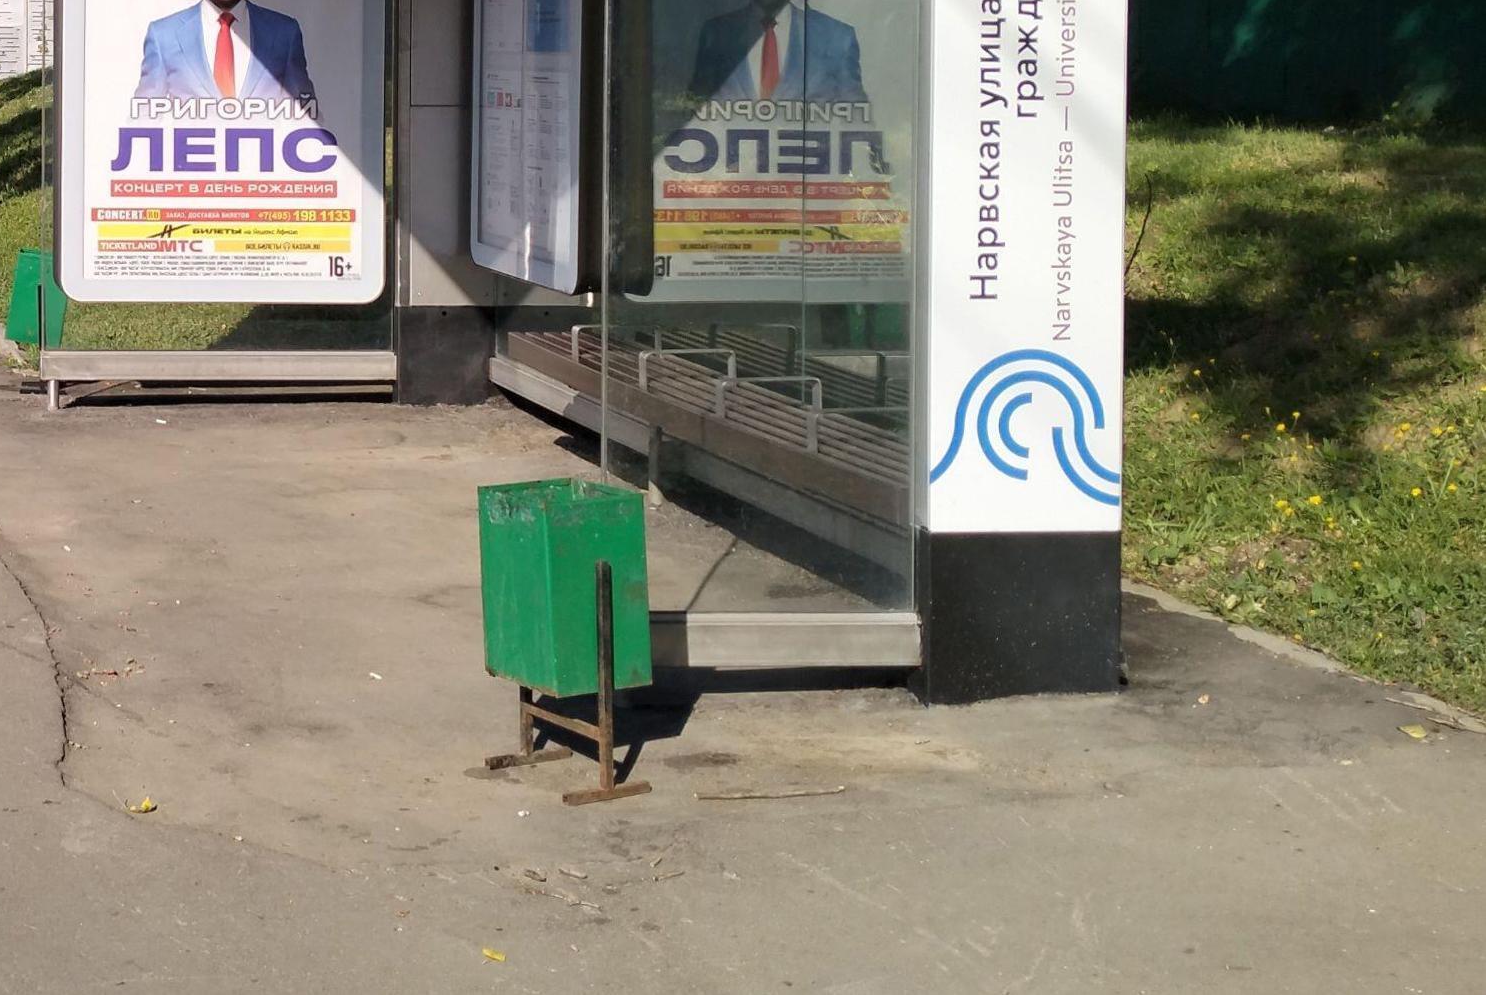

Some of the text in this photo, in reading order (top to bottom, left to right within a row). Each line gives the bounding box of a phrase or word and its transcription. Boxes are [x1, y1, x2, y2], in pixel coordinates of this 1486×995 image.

[130, 93, 318, 120] ГРИГОРИЙ
[110, 127, 338, 174] ЛЕПС
[1052, 140, 1073, 207] Ulitsa
[114, 183, 334, 195] КОНЦЕРТ В ДЕНЬ РОЖДЕНИЯ
[293, 210, 317, 222] 198
[320, 210, 351, 222] 1133
[969, 119, 1006, 300] Нарвская
[192, 227, 242, 235] БИЛЕТЫ
[160, 240, 203, 253] МТС
[328, 255, 352, 277] 16+
[1051, 215, 1076, 341] Narvskaya
